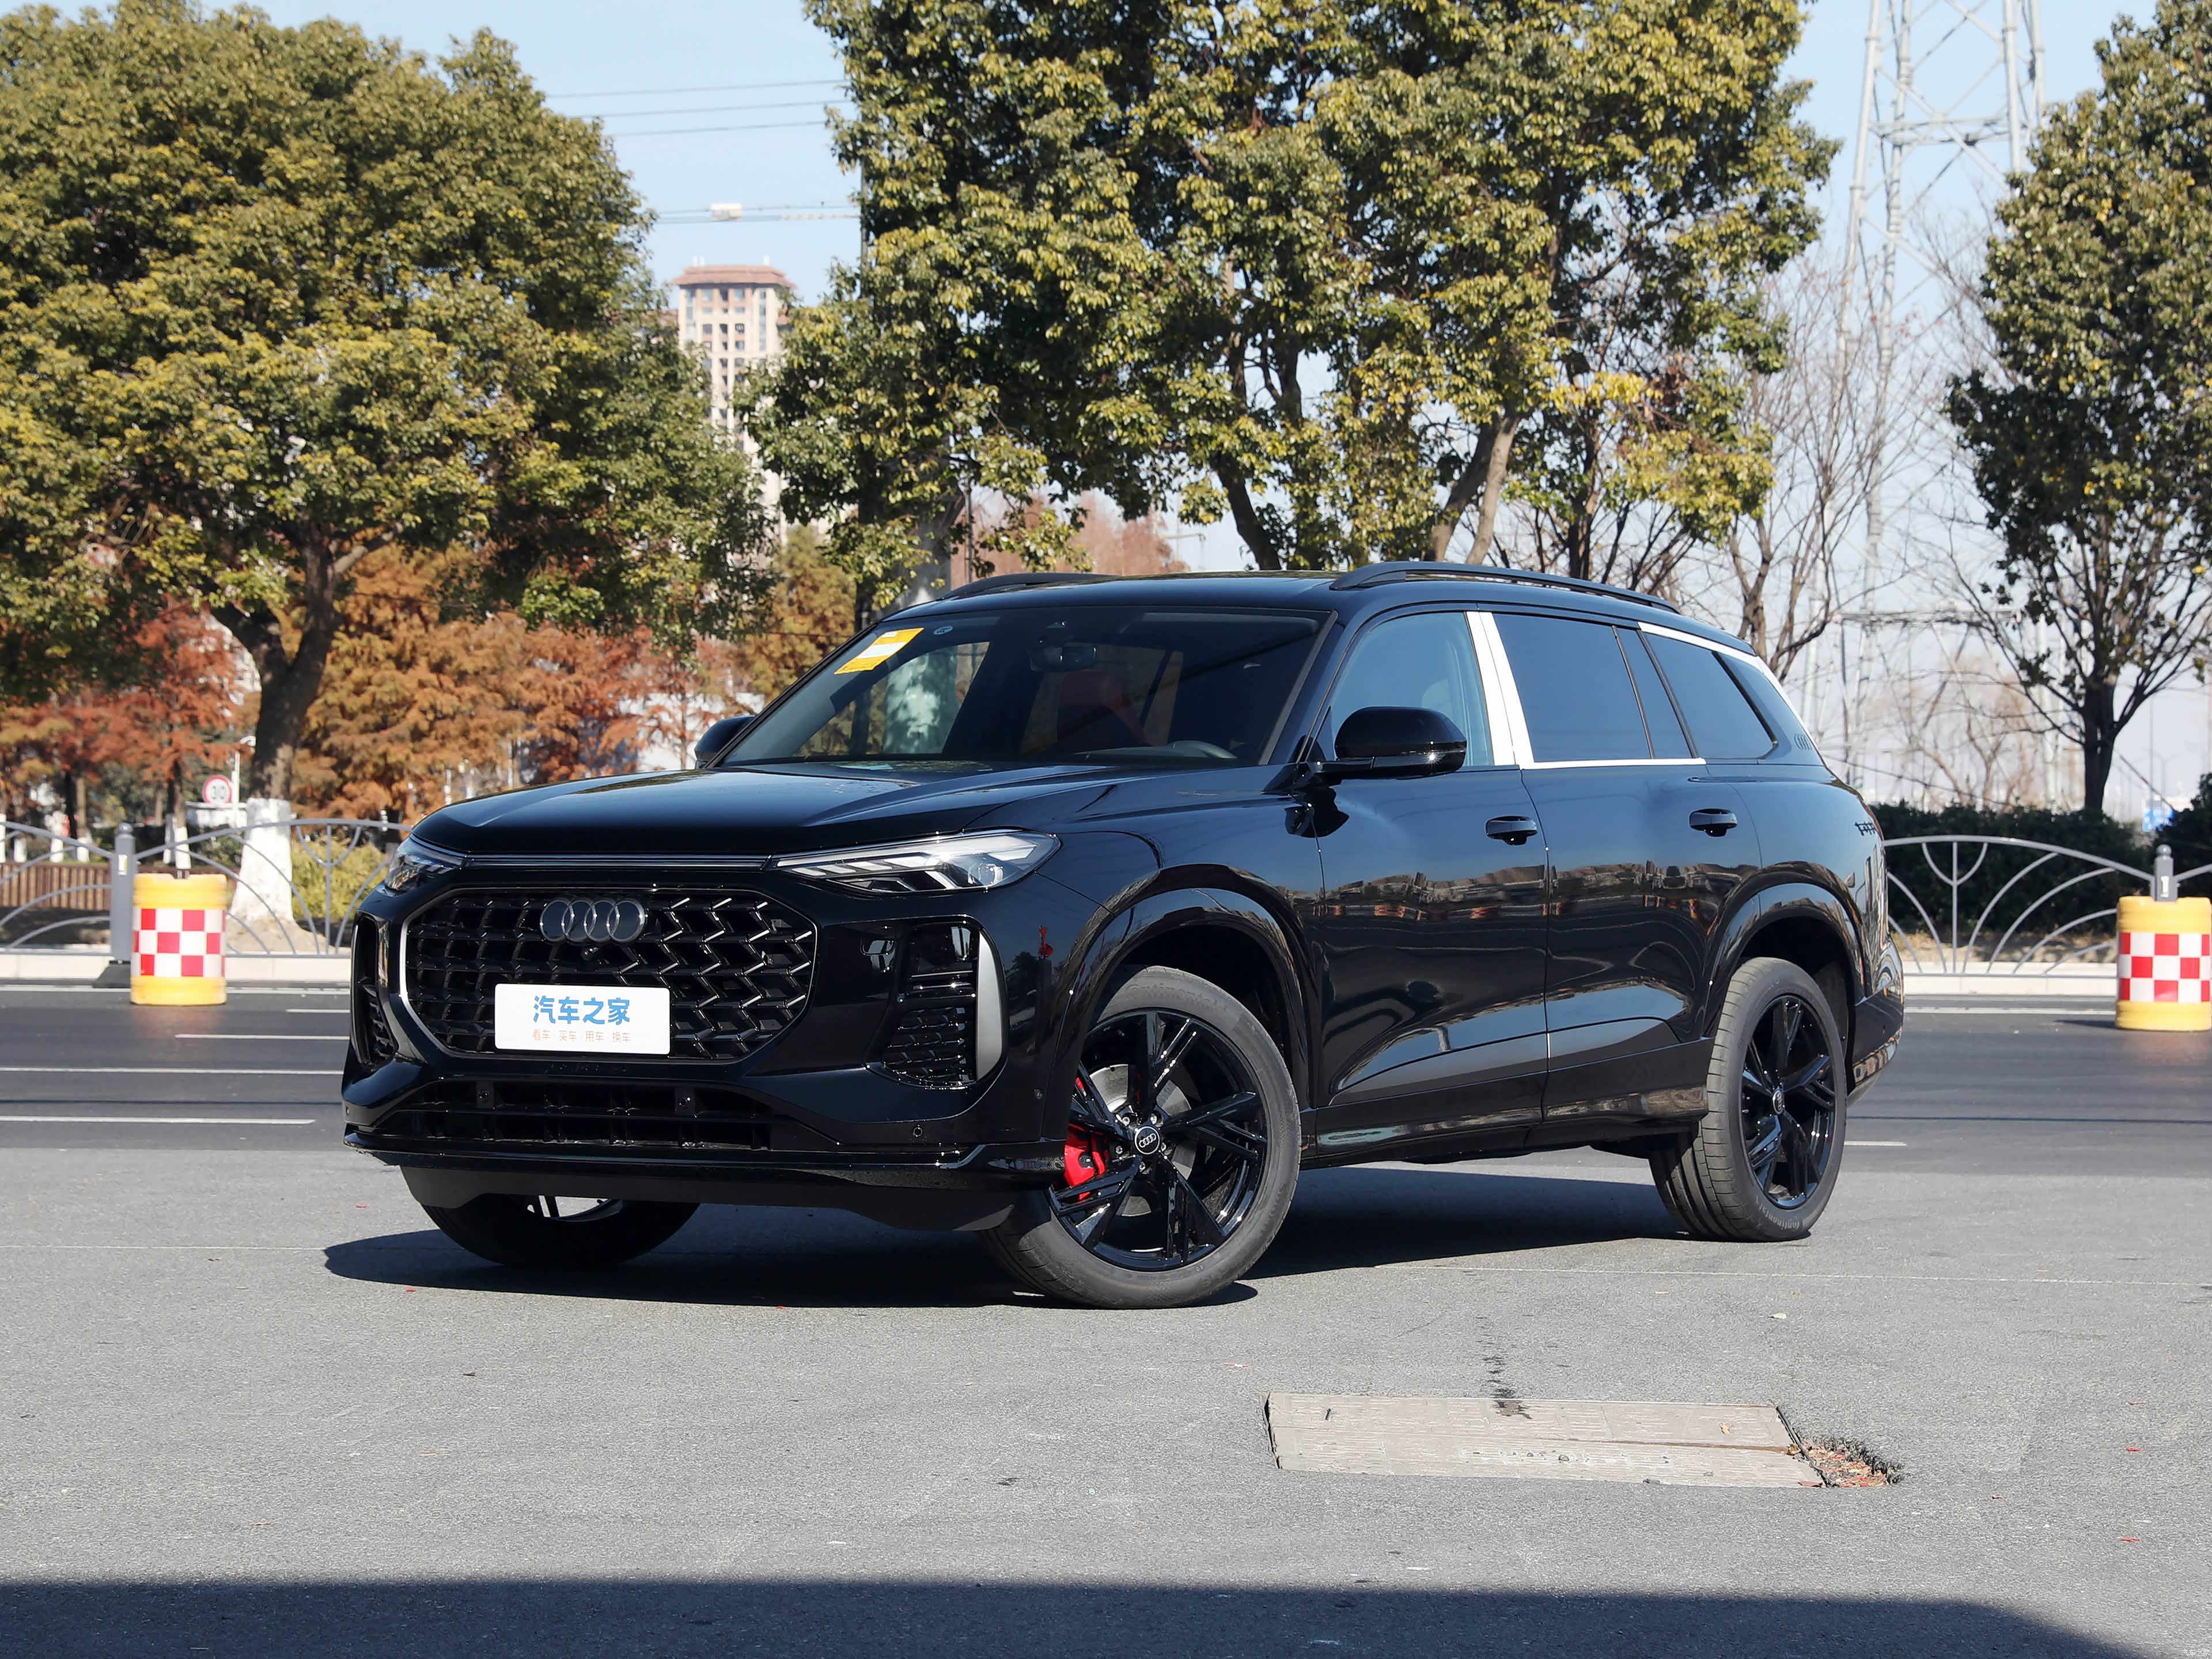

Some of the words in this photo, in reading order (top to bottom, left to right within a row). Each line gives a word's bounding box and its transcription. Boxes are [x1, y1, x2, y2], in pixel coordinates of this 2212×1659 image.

[533, 995, 630, 1025] 汽车之家
[532, 1029, 551, 1041] 看车
[559, 1029, 577, 1041] 买车
[585, 1031, 604, 1042] 用车
